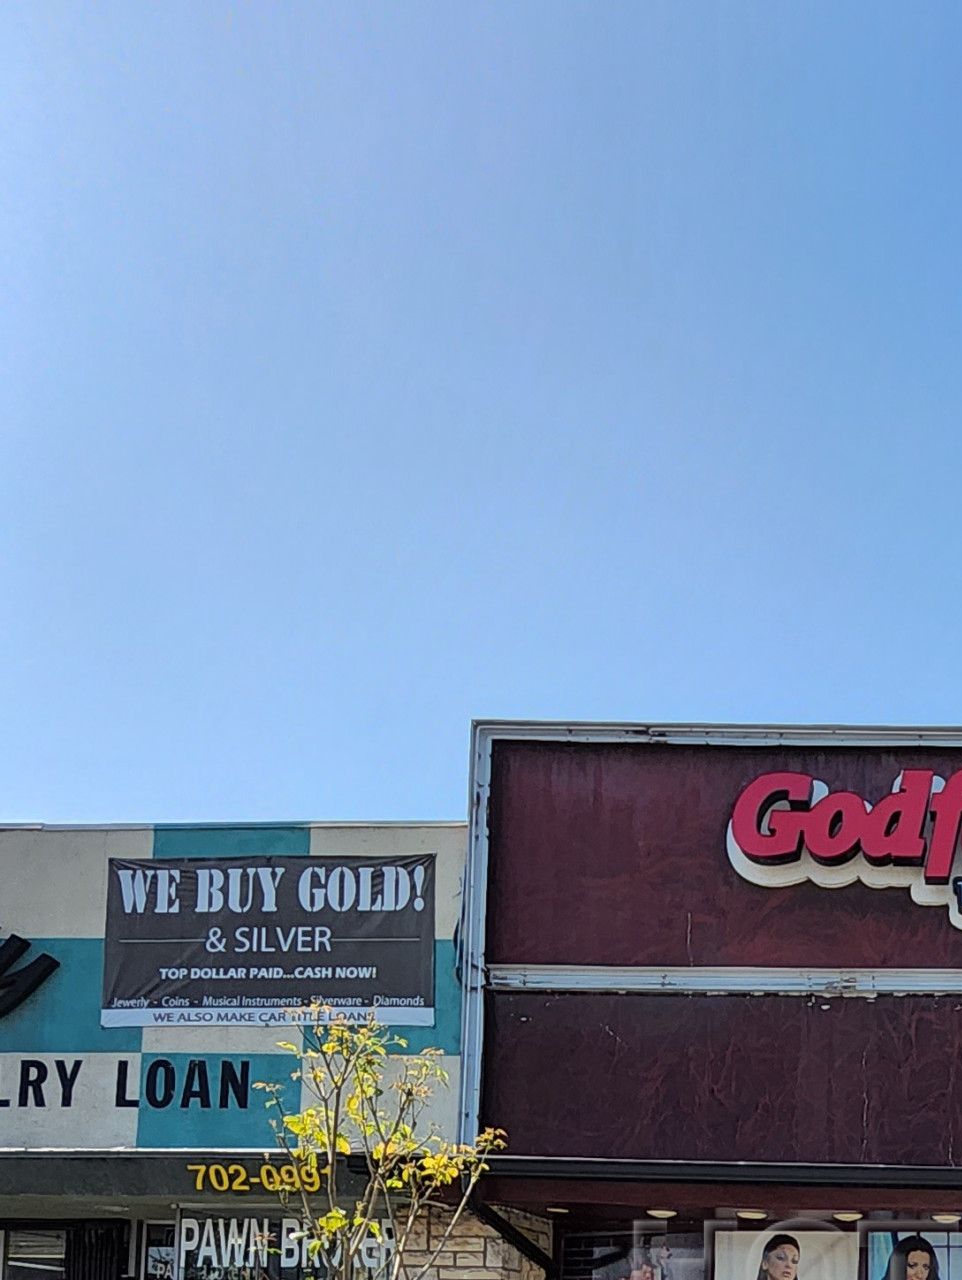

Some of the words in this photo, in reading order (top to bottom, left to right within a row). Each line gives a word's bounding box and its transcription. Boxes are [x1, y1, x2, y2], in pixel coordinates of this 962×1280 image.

[118, 869, 181, 914] WE
[195, 867, 285, 913] BUY
[298, 866, 425, 912] GOLD!
[205, 926, 227, 953] &
[234, 926, 332, 952] SILVER
[159, 968, 187, 980] TOP
[190, 967, 246, 979] DOLLAR
[335, 966, 377, 979] NOW!
[161, 996, 190, 1007] Coins
[202, 996, 240, 1007] Musical
[241, 995, 301, 1007] Instruments
[373, 995, 425, 1007] Diamonds
[153, 1013, 174, 1023] WE
[177, 1013, 213, 1022] ALSO
[216, 1012, 255, 1022] MAKE
[258, 1012, 286, 1022] CAR
[0, 1060, 83, 1108] RY
[115, 1060, 249, 1108] LOAN
[181, 1218, 269, 1268] PAWN
